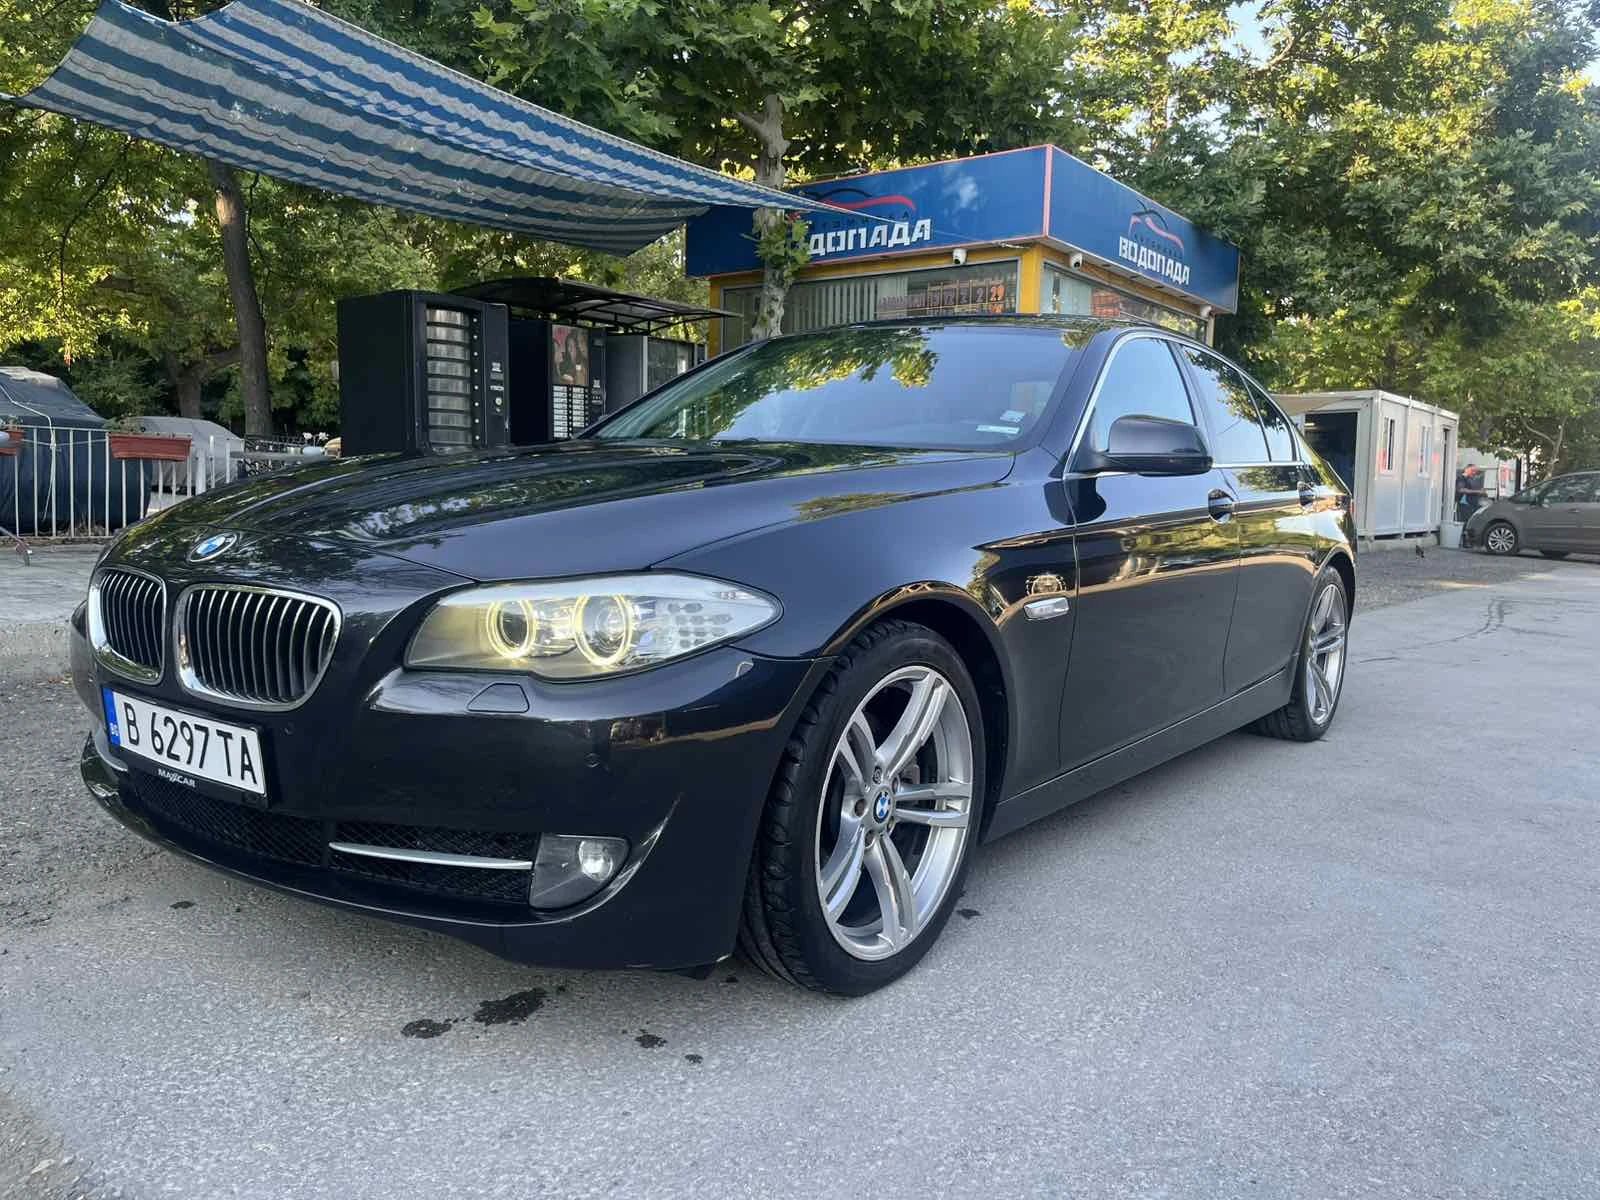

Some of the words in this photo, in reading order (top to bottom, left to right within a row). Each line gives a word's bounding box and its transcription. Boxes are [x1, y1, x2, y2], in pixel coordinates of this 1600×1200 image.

[807, 218, 931, 256] ДОПАДА
[1118, 236, 1190, 285] ВОДОПАДА
[124, 702, 140, 746] B
[151, 711, 210, 769] 6297
[216, 729, 258, 785] TA
